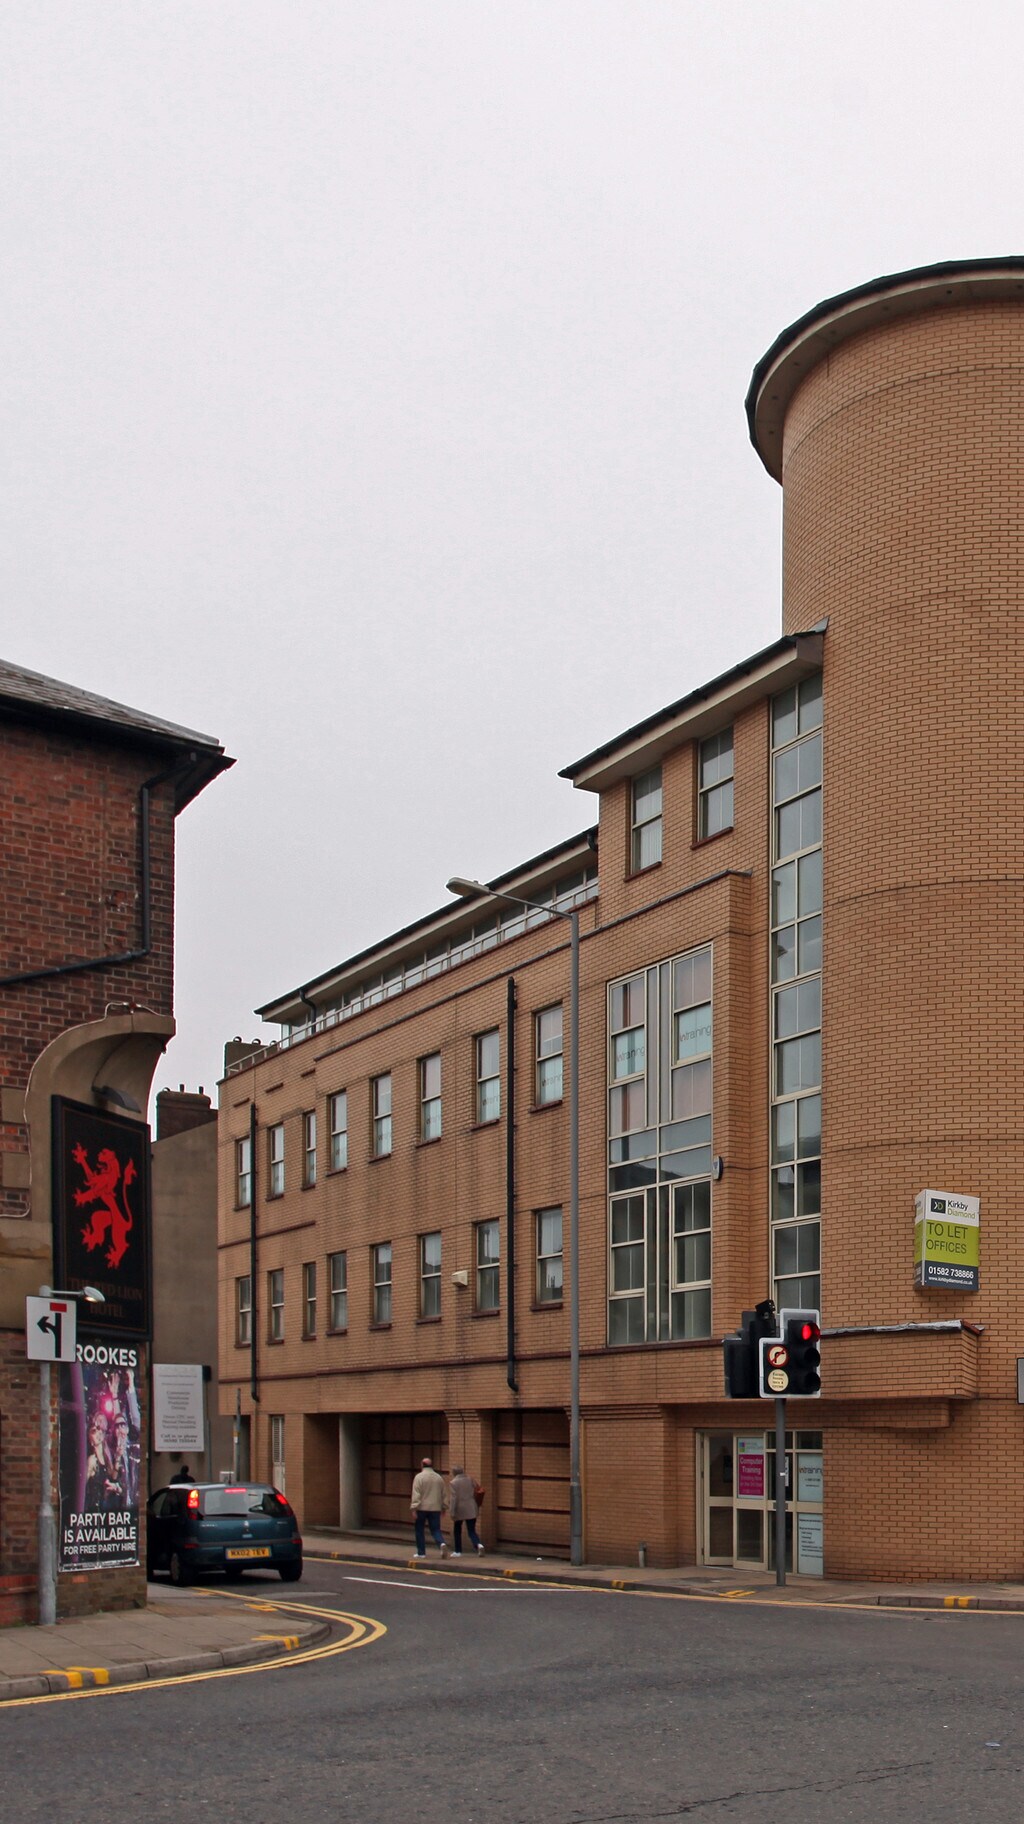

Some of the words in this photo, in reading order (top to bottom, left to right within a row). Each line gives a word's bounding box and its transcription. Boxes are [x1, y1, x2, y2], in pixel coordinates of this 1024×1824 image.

[947, 1200, 968, 1211] Kirkby
[947, 1209, 975, 1219] Diamond
[926, 1222, 944, 1237] TO
[948, 1225, 968, 1239] LET
[926, 1239, 967, 1254] OFFICES
[928, 1266, 949, 1276] 01582
[950, 1268, 974, 1279] 738866
[70, 1513, 106, 1527] PARTY
[108, 1511, 131, 1526] BAR
[64, 1529, 74, 1544] IS
[76, 1526, 137, 1542] AVAILABLE
[64, 1546, 79, 1555] FOR
[80, 1544, 97, 1554] FREE
[98, 1543, 120, 1553] PARTY
[121, 1542, 137, 1551] HIRE
